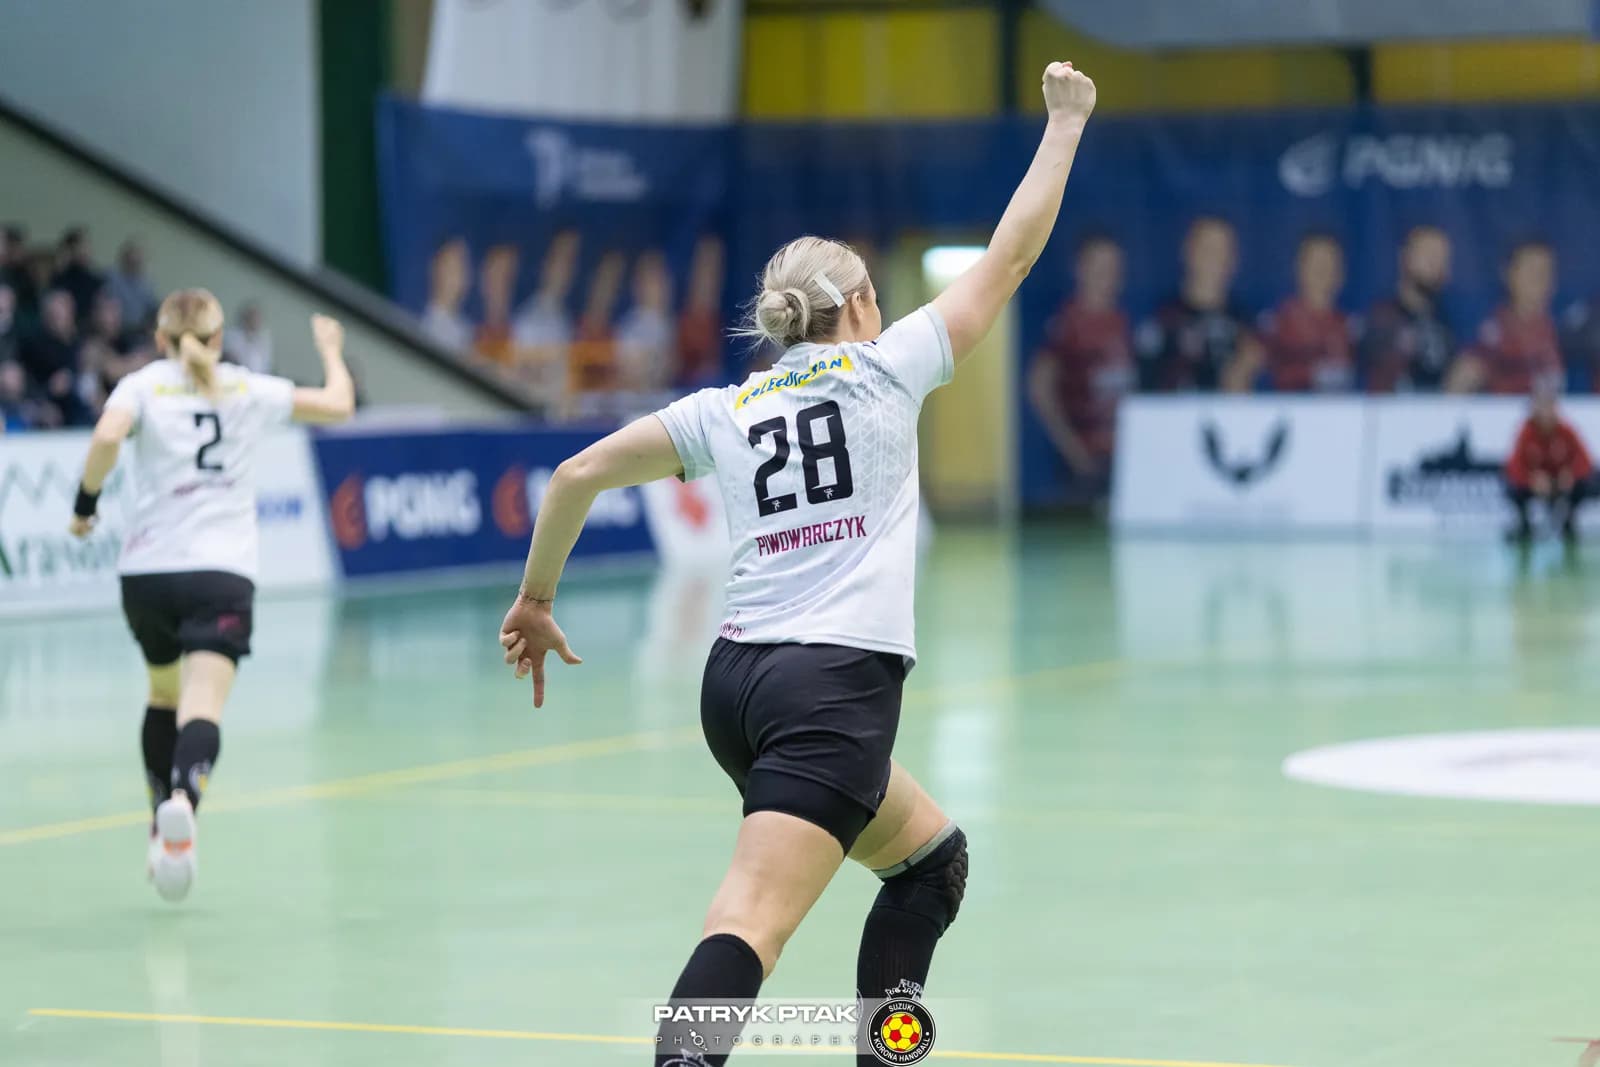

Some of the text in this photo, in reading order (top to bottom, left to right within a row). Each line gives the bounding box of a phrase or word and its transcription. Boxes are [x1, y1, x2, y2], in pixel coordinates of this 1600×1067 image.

[194, 413, 223, 470] 2
[748, 400, 853, 517] 28
[755, 515, 867, 557] PIWOWARCZYK
